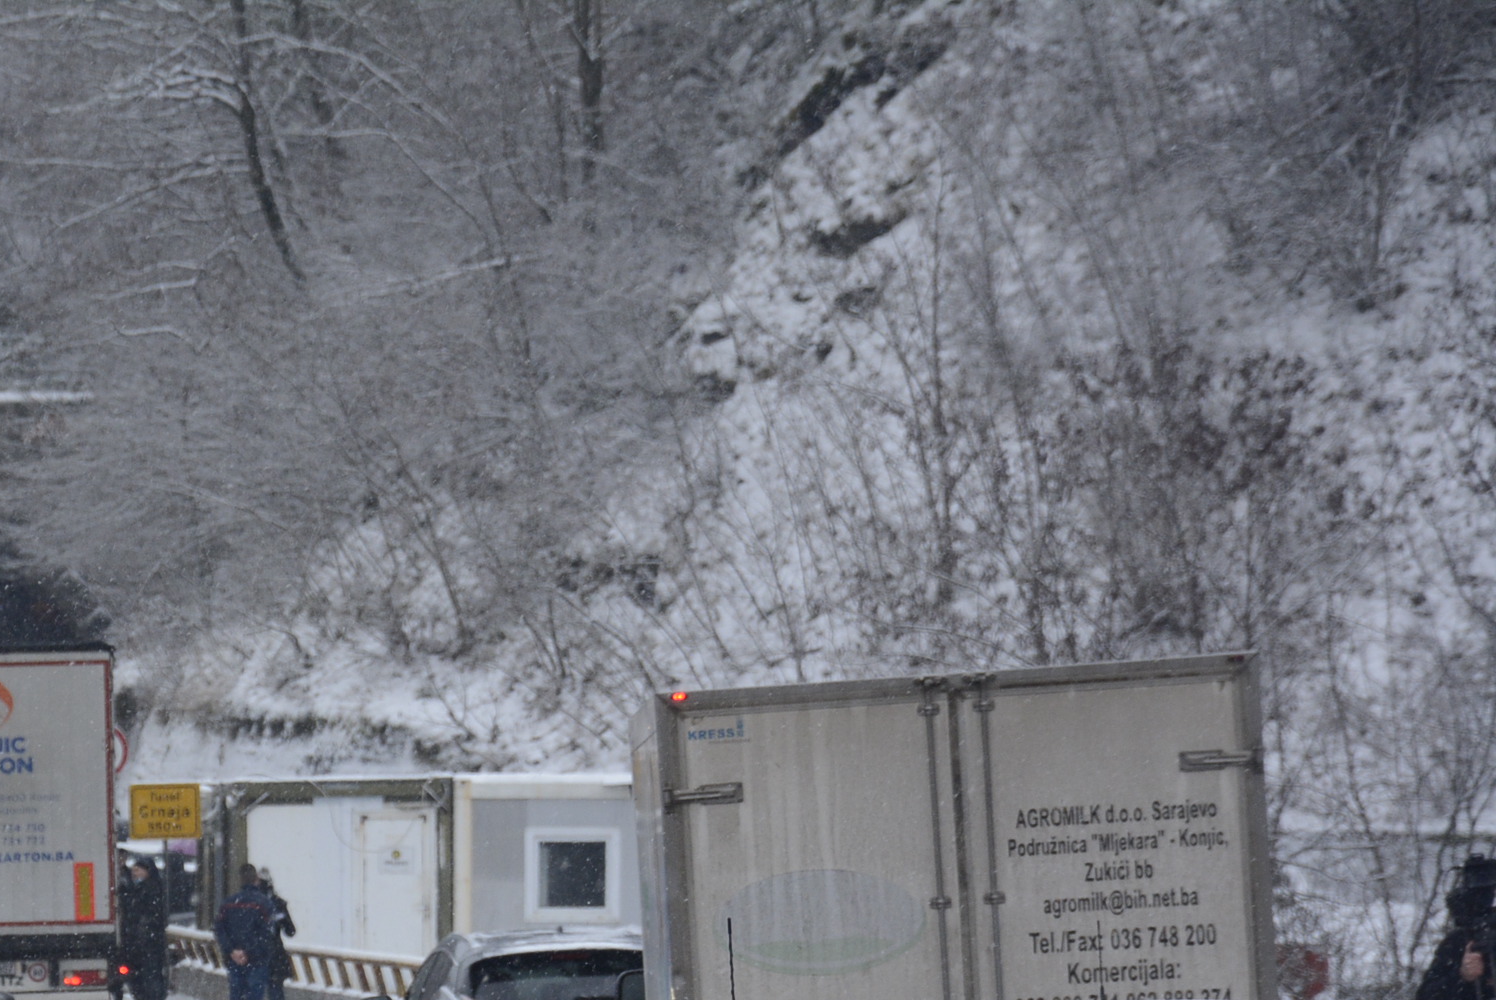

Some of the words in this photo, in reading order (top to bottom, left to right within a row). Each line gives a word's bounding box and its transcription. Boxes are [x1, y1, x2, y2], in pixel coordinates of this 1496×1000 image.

[687, 728, 735, 741] KRESS
[1016, 804, 1101, 828] AGROMILK
[1105, 803, 1147, 824] d.o.o.
[1152, 800, 1217, 825] Sarajevo
[1007, 835, 1087, 857] Podružnica
[1091, 830, 1166, 856] "Mljekara"
[1178, 828, 1229, 851] Konjic,
[1134, 859, 1153, 880] bb
[1044, 889, 1199, 918] agromilk@bih.net.ba
[1029, 930, 1104, 955] Tel./Fax:
[1110, 928, 1142, 950] 036
[1148, 925, 1179, 948] 748
[1185, 923, 1217, 946] 200
[1067, 959, 1182, 986] Komercijala:
